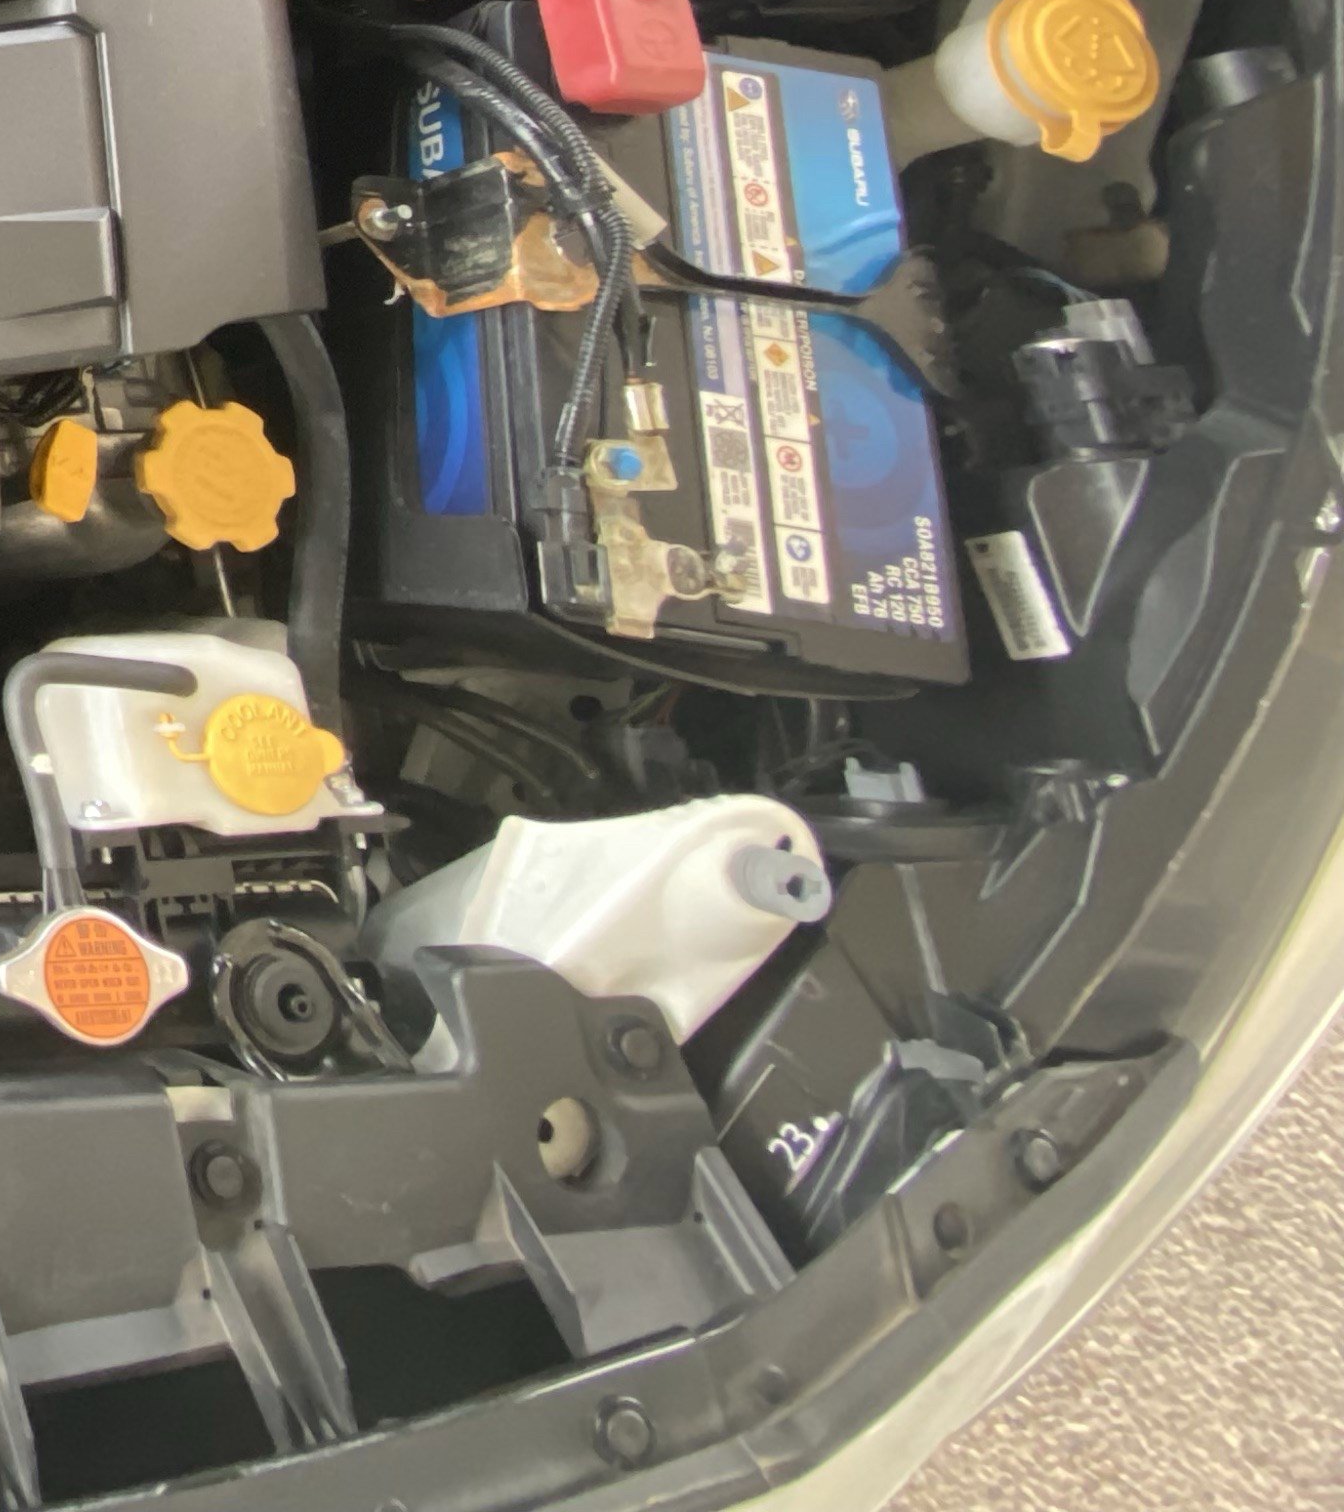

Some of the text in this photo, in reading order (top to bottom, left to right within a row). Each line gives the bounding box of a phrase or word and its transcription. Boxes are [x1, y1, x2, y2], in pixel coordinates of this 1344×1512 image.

[847, 128, 870, 206] SUBARU
[793, 270, 818, 391] DER/POISON
[851, 583, 870, 615] EFB
[868, 571, 885, 594] Ah
[885, 564, 907, 622] RC 120
[902, 556, 925, 625] CCA 750
[220, 701, 307, 740] COOLANT
